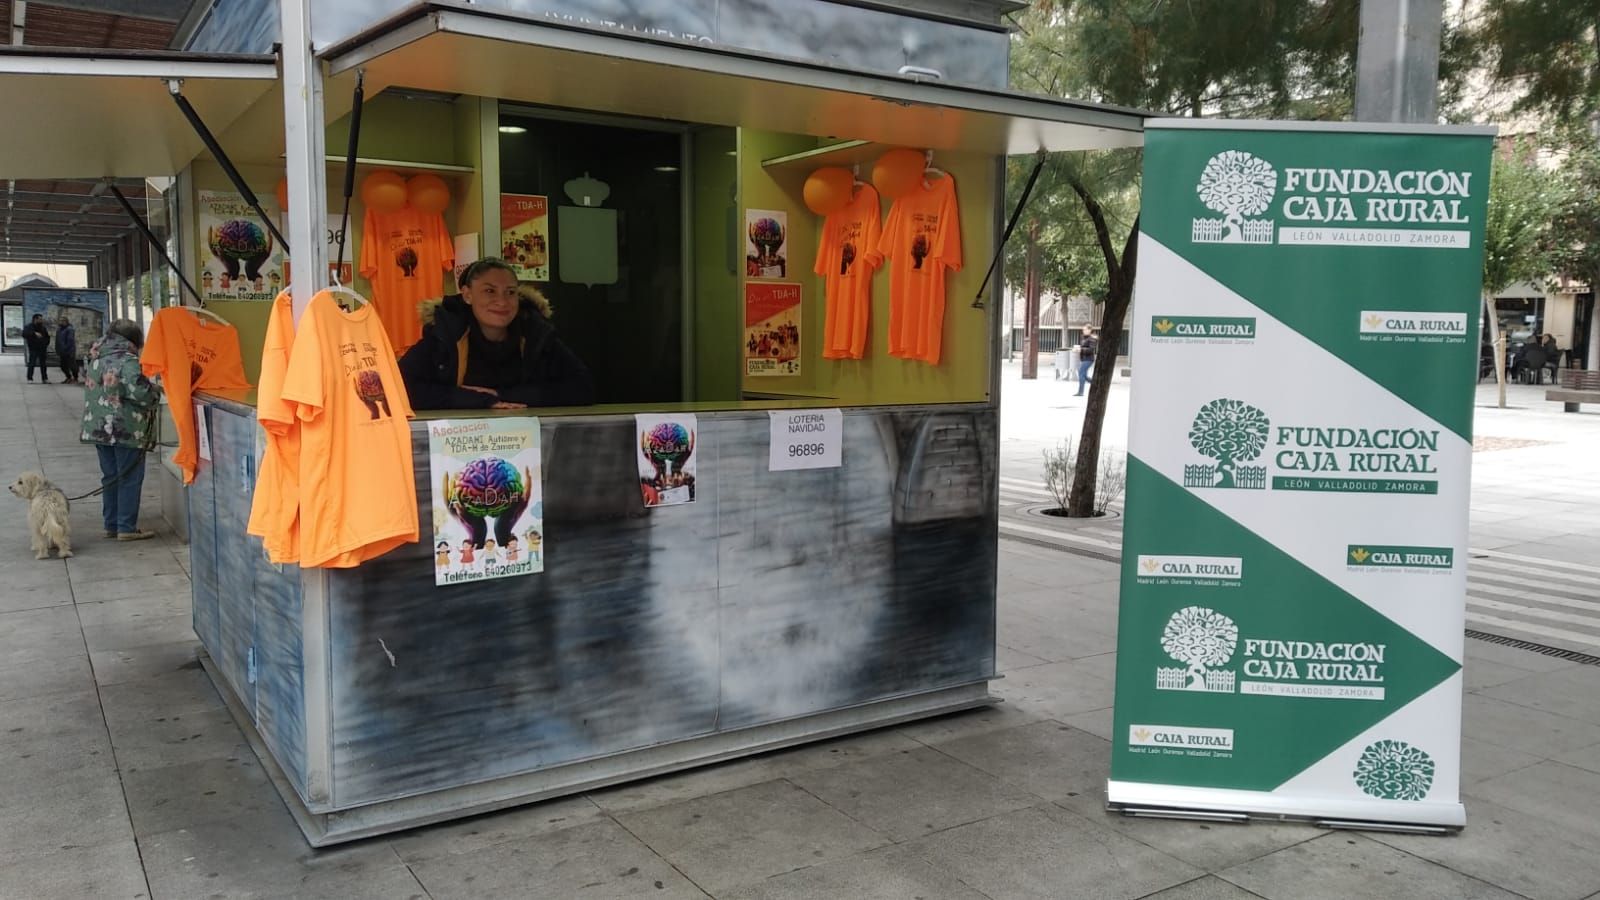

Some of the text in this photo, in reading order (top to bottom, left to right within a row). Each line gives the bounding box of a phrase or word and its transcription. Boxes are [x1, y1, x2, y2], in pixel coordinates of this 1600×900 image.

[1283, 168, 1472, 197] FUNDACIÓN
[516, 200, 543, 210] TDA-H
[1282, 196, 1470, 224] CAJA RURAL
[1293, 229, 1456, 244] LEÓN VALLADOLID ZAMORA
[772, 287, 798, 300] TDA-H
[1176, 323, 1253, 336] CAJA RURAL
[1386, 319, 1464, 331] CAJA RURAL
[788, 415, 824, 424] LOTERIA
[432, 422, 490, 437] Asociación
[788, 423, 825, 433] NAVIDAD
[488, 434, 518, 444] Autismo
[520, 435, 527, 444] y
[1276, 426, 1440, 451] FUNDACIÓN
[451, 442, 521, 454] TDA-H de Zamora
[788, 443, 825, 457] 96896
[1275, 450, 1437, 473] CAJA RURAL
[1284, 478, 1426, 491] LEÓN VALLADOLID ZAMORA
[1371, 552, 1451, 566] CAJA RURAL
[444, 561, 532, 582] Teléfono 640260973
[1162, 563, 1239, 576] CAJA RURAL
[1243, 638, 1387, 664] FUNDACIÓN
[1243, 659, 1384, 682] CAJA RURAL
[1251, 682, 1375, 697] LEÓN VALLADOLID ZAMORA
[1153, 732, 1231, 747] CAJA RURAL
